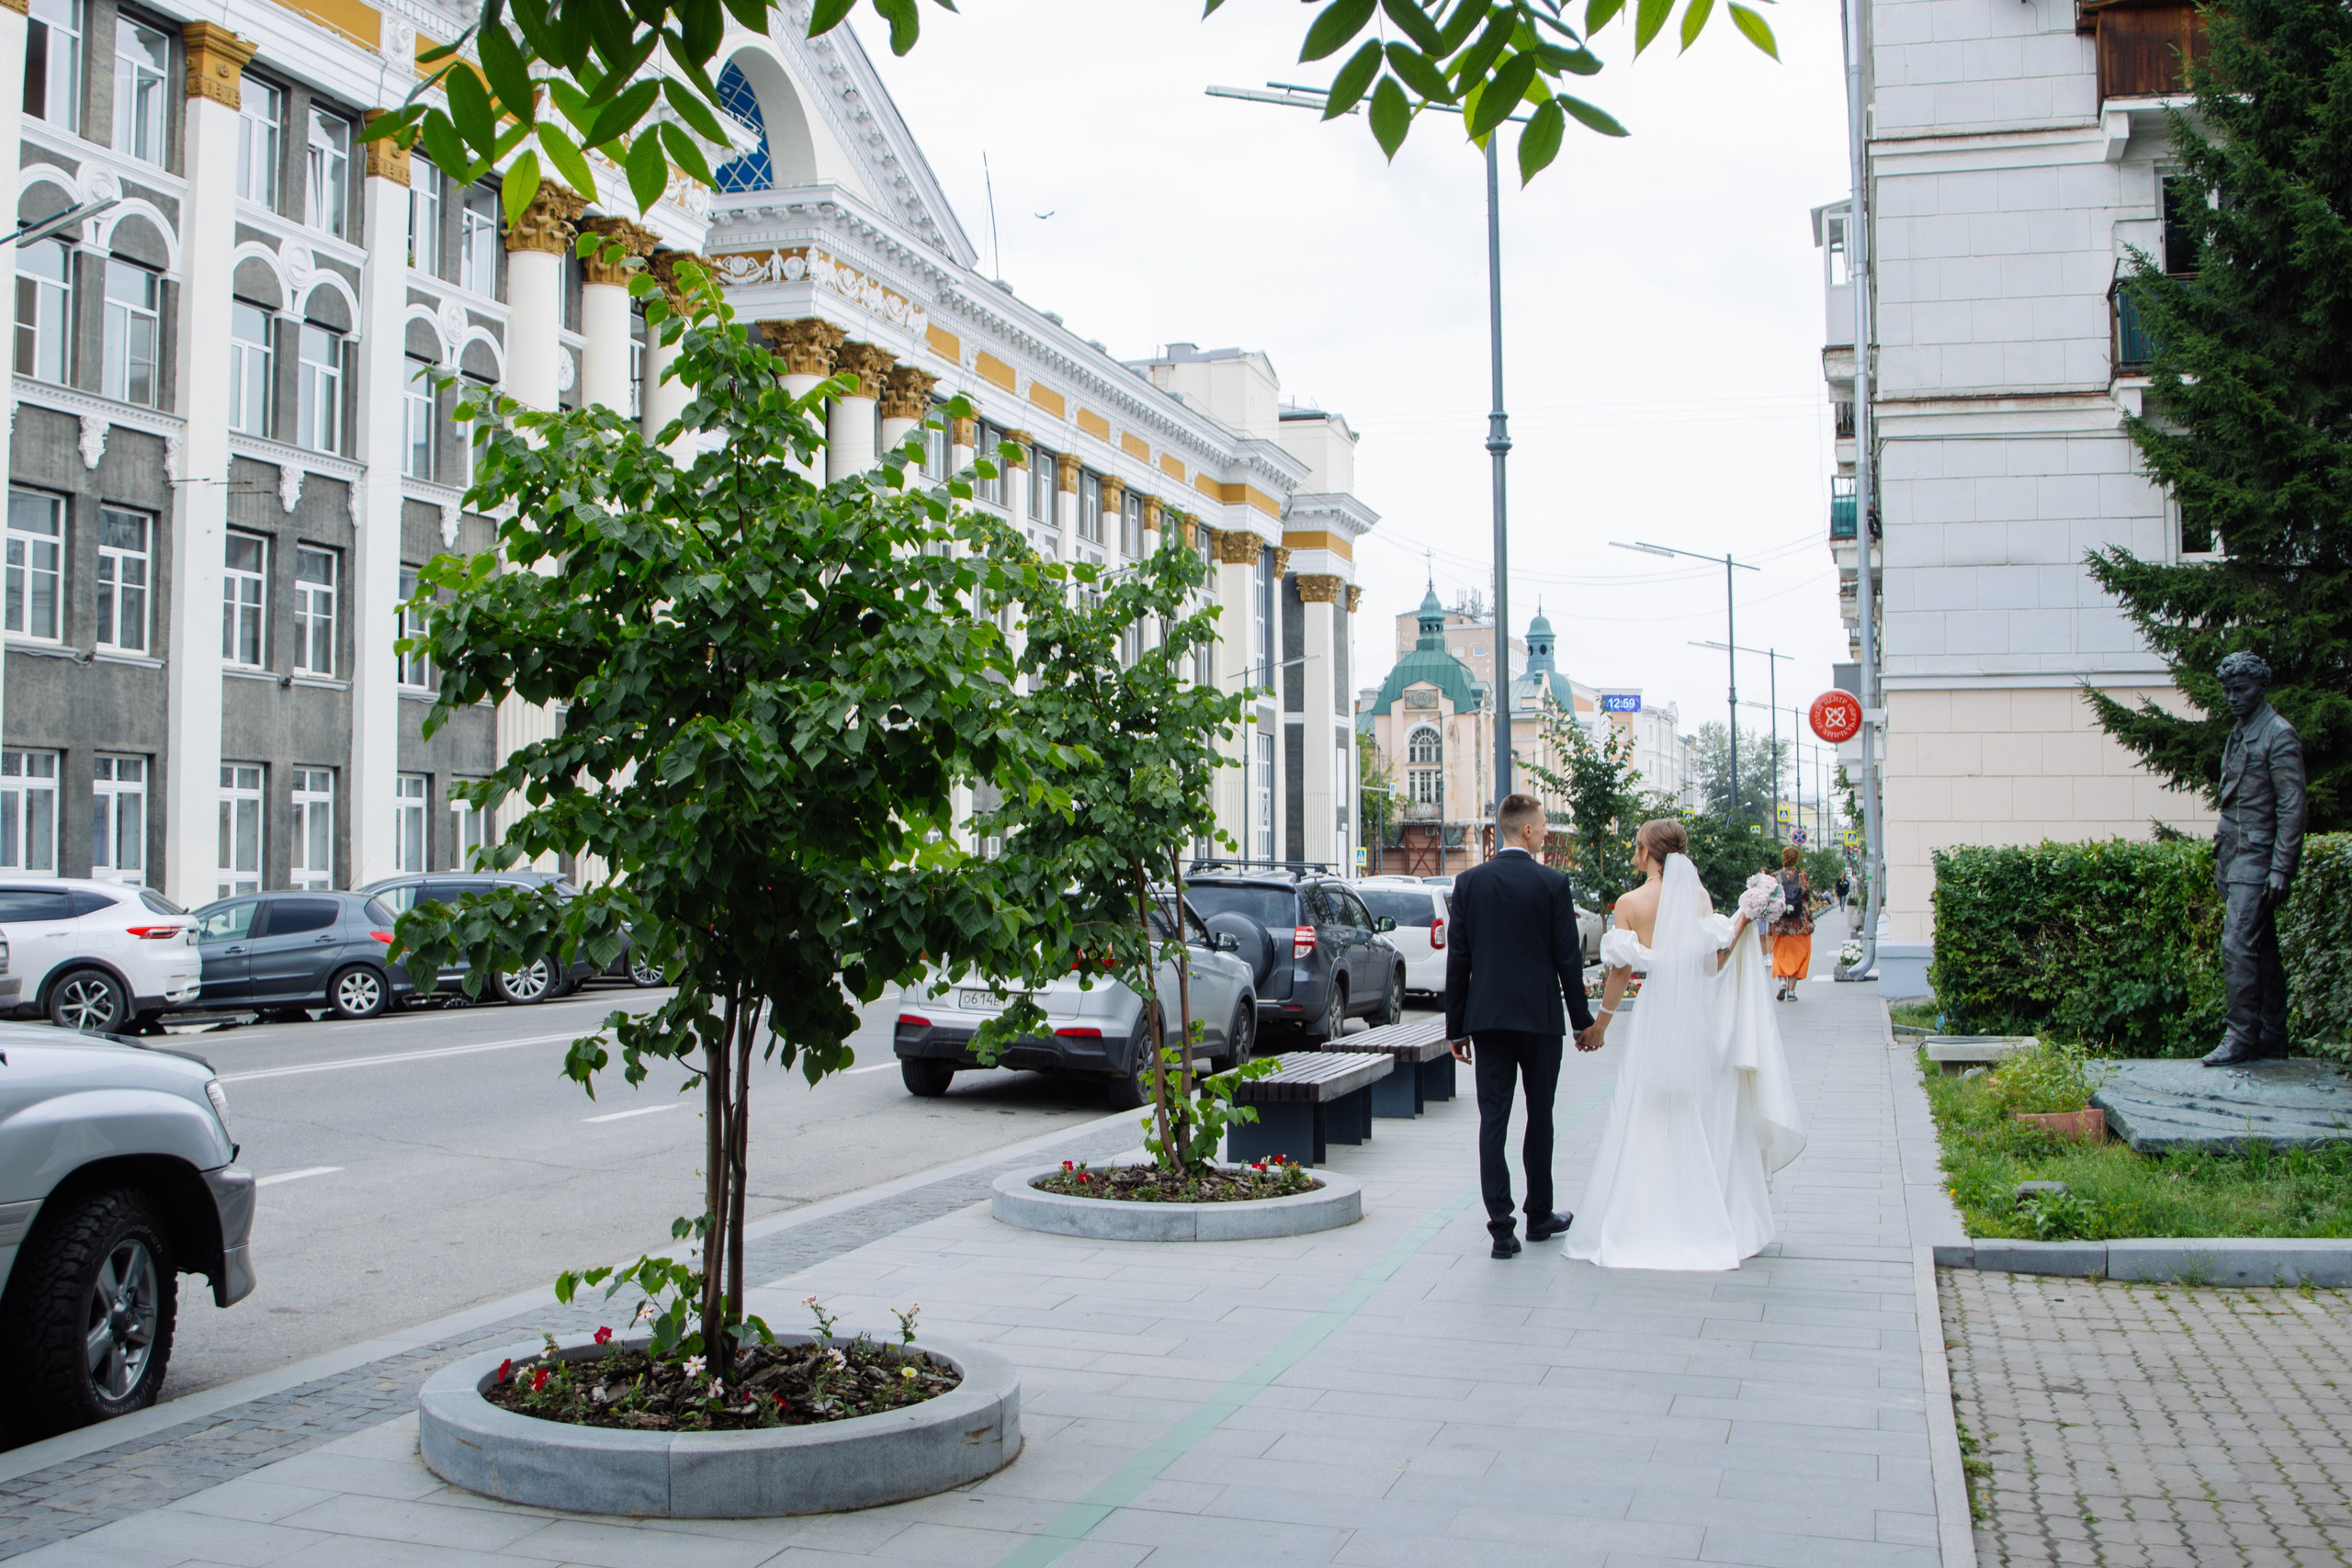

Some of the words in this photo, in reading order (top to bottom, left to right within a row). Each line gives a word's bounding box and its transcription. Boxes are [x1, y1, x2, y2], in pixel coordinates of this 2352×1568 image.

[1609, 698, 1635, 709] 12:59
[1823, 695, 1848, 705] ЦЕНТР
[1815, 704, 1824, 729] КОЛЕЦ
[1823, 703, 1858, 738] ОБРУЧАЛЬНЫХ
[964, 993, 1005, 1006] О614Е
